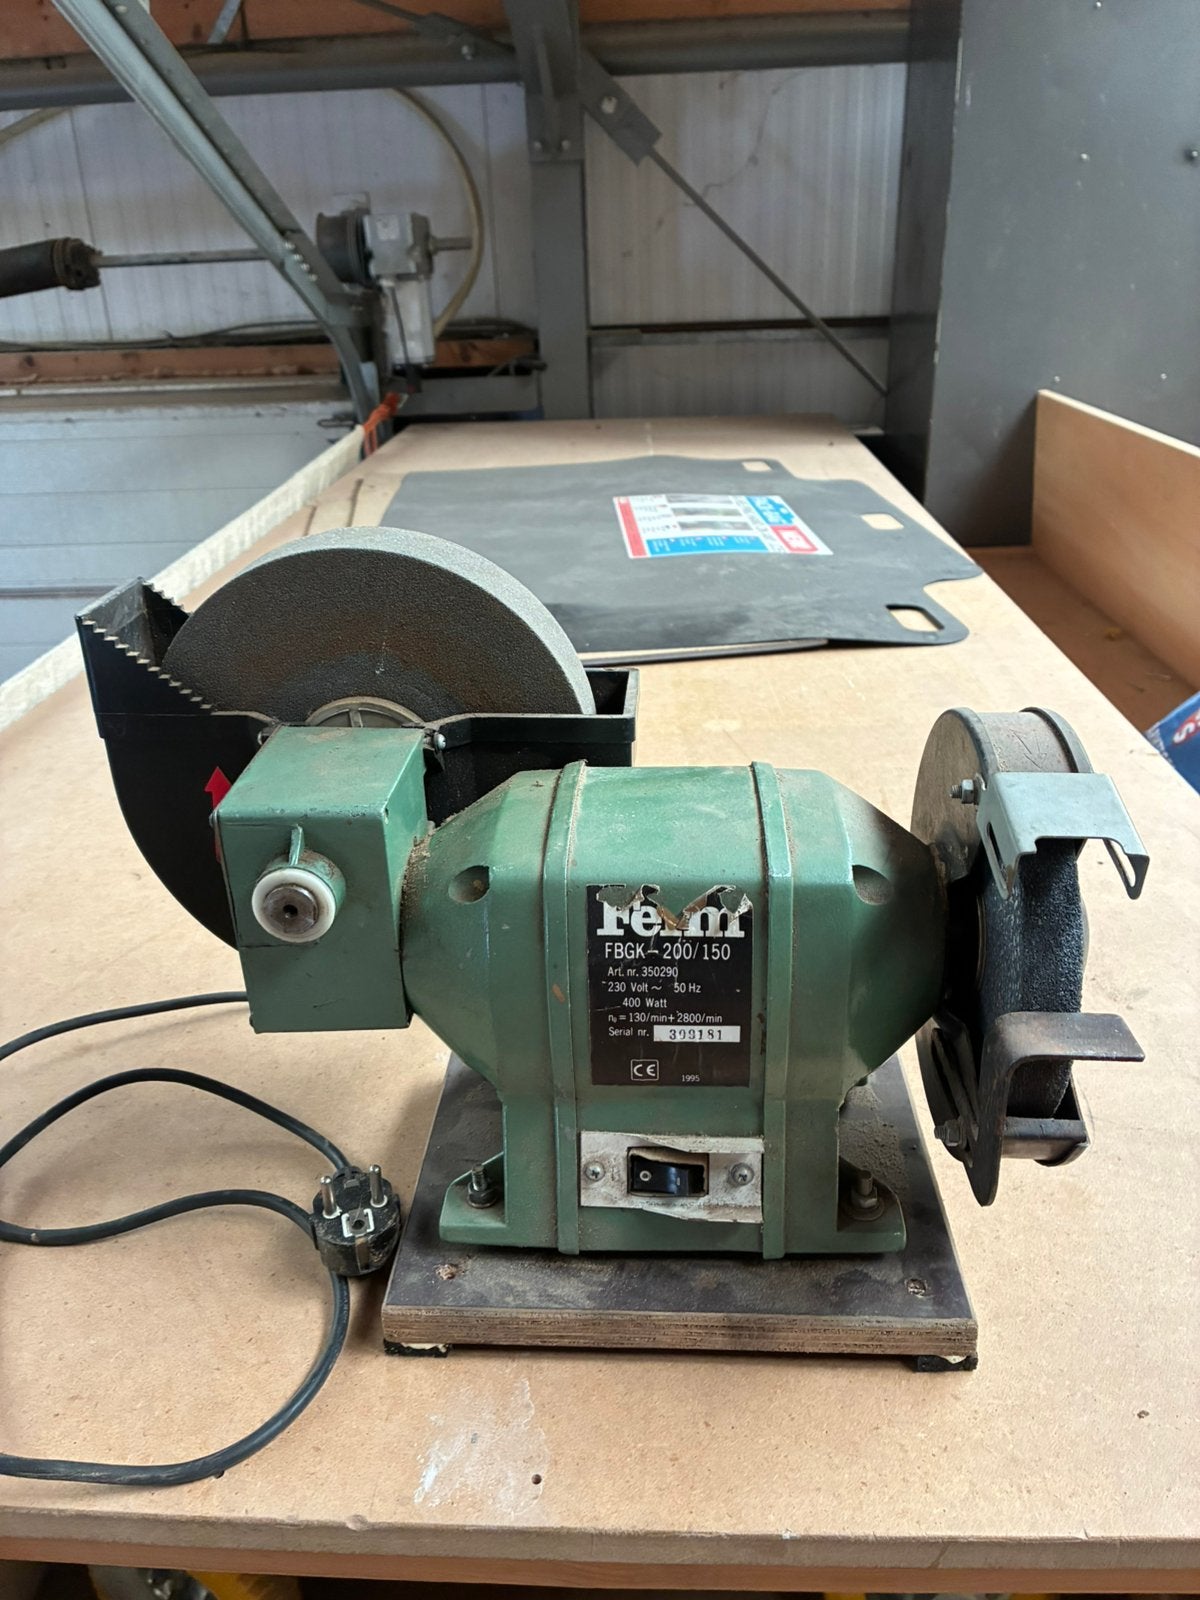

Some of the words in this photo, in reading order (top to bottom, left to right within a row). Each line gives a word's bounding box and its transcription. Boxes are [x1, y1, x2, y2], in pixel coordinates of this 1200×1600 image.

[607, 966, 624, 977] Art.
[627, 968, 639, 977] nr.
[641, 966, 679, 978] 350290
[607, 981, 627, 993] 230
[630, 981, 649, 993] Volt
[673, 982, 687, 994] 50
[688, 982, 702, 994] Hz
[622, 997, 641, 1008] 400
[645, 997, 668, 1009] Watt
[608, 1026, 634, 1037] Serial
[637, 1028, 650, 1037] nr.
[633, 1063, 656, 1077] CE
[681, 1074, 701, 1083] 1995
